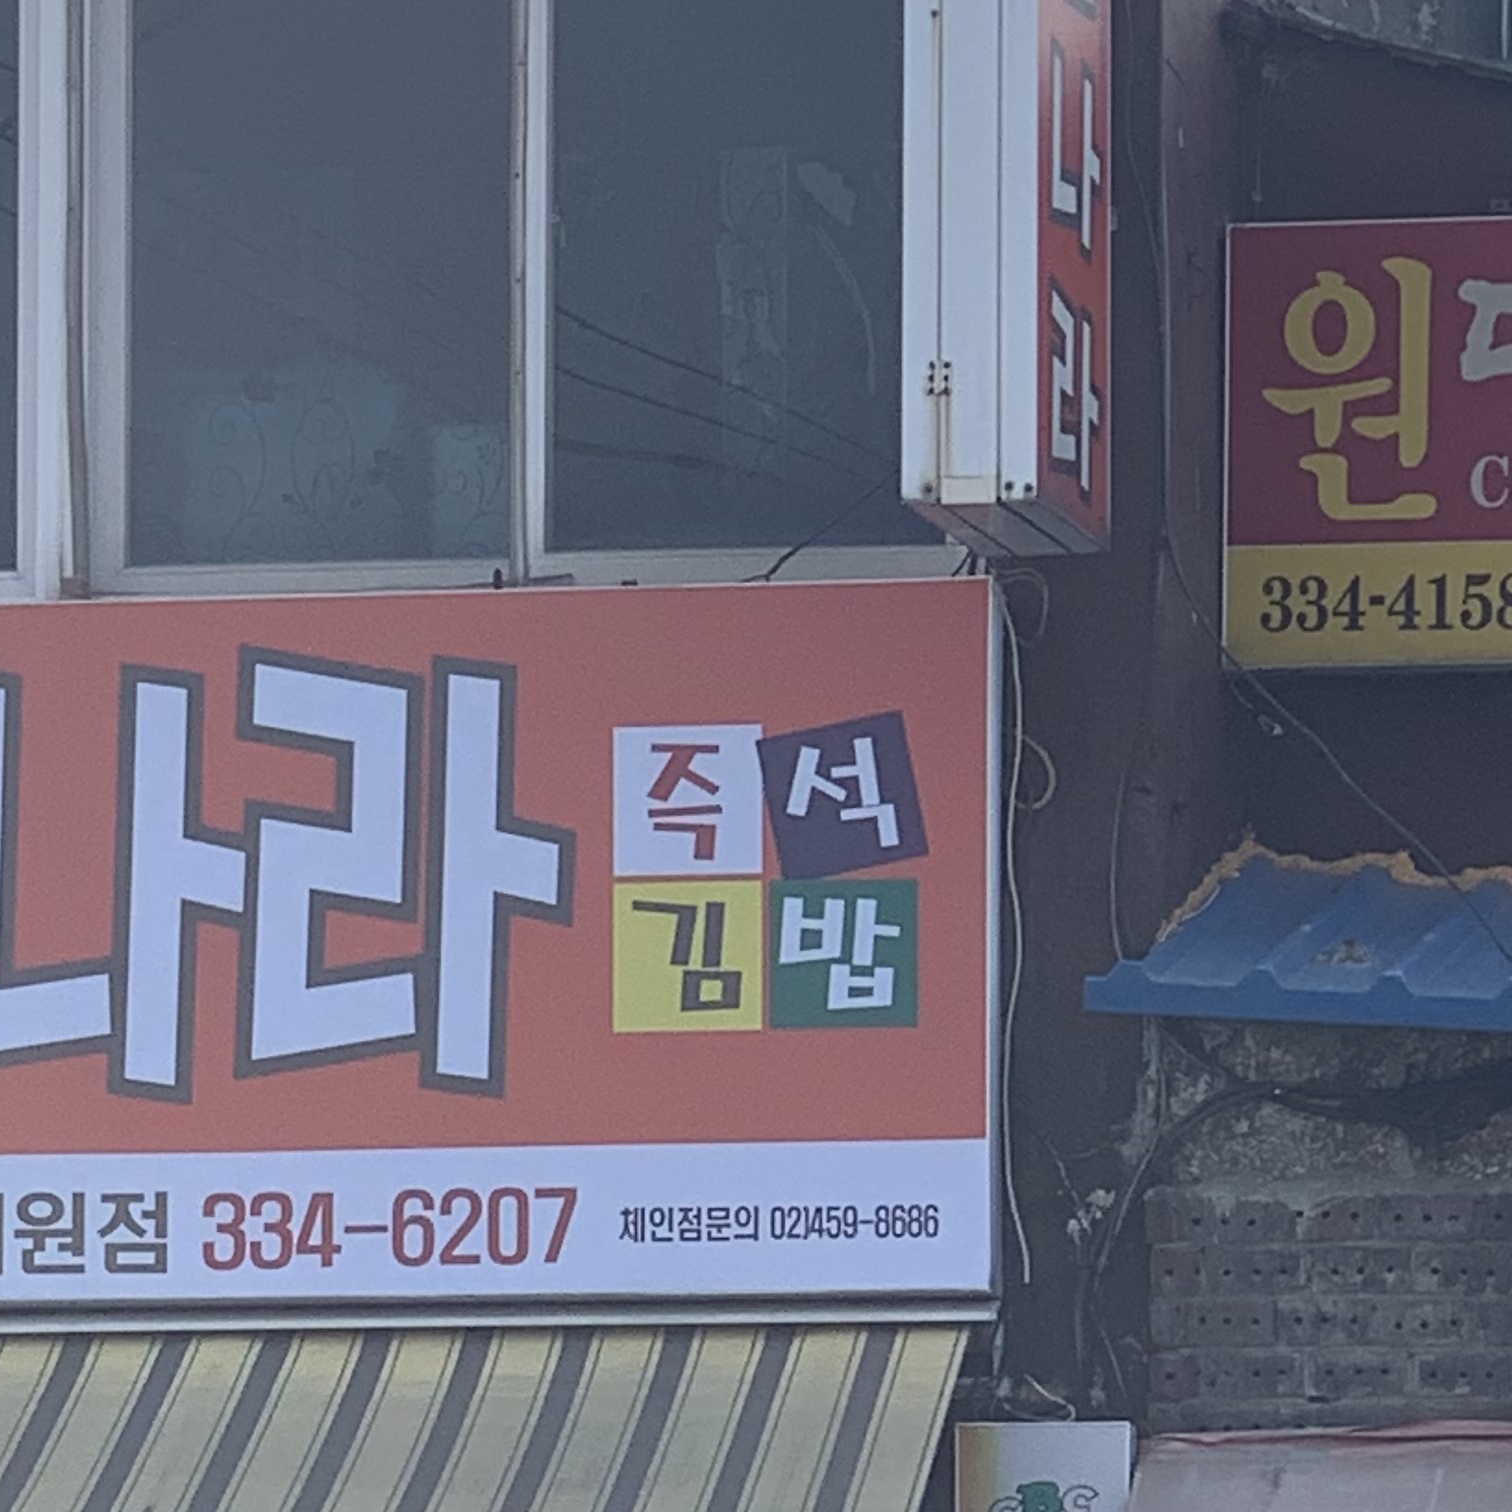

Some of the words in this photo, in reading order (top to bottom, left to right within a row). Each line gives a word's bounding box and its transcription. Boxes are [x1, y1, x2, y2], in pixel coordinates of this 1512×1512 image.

[201, 1186, 579, 1272] 334-6207
[619, 1205, 760, 1244] 체인점문의
[769, 1203, 940, 1241] 02)459-8686
